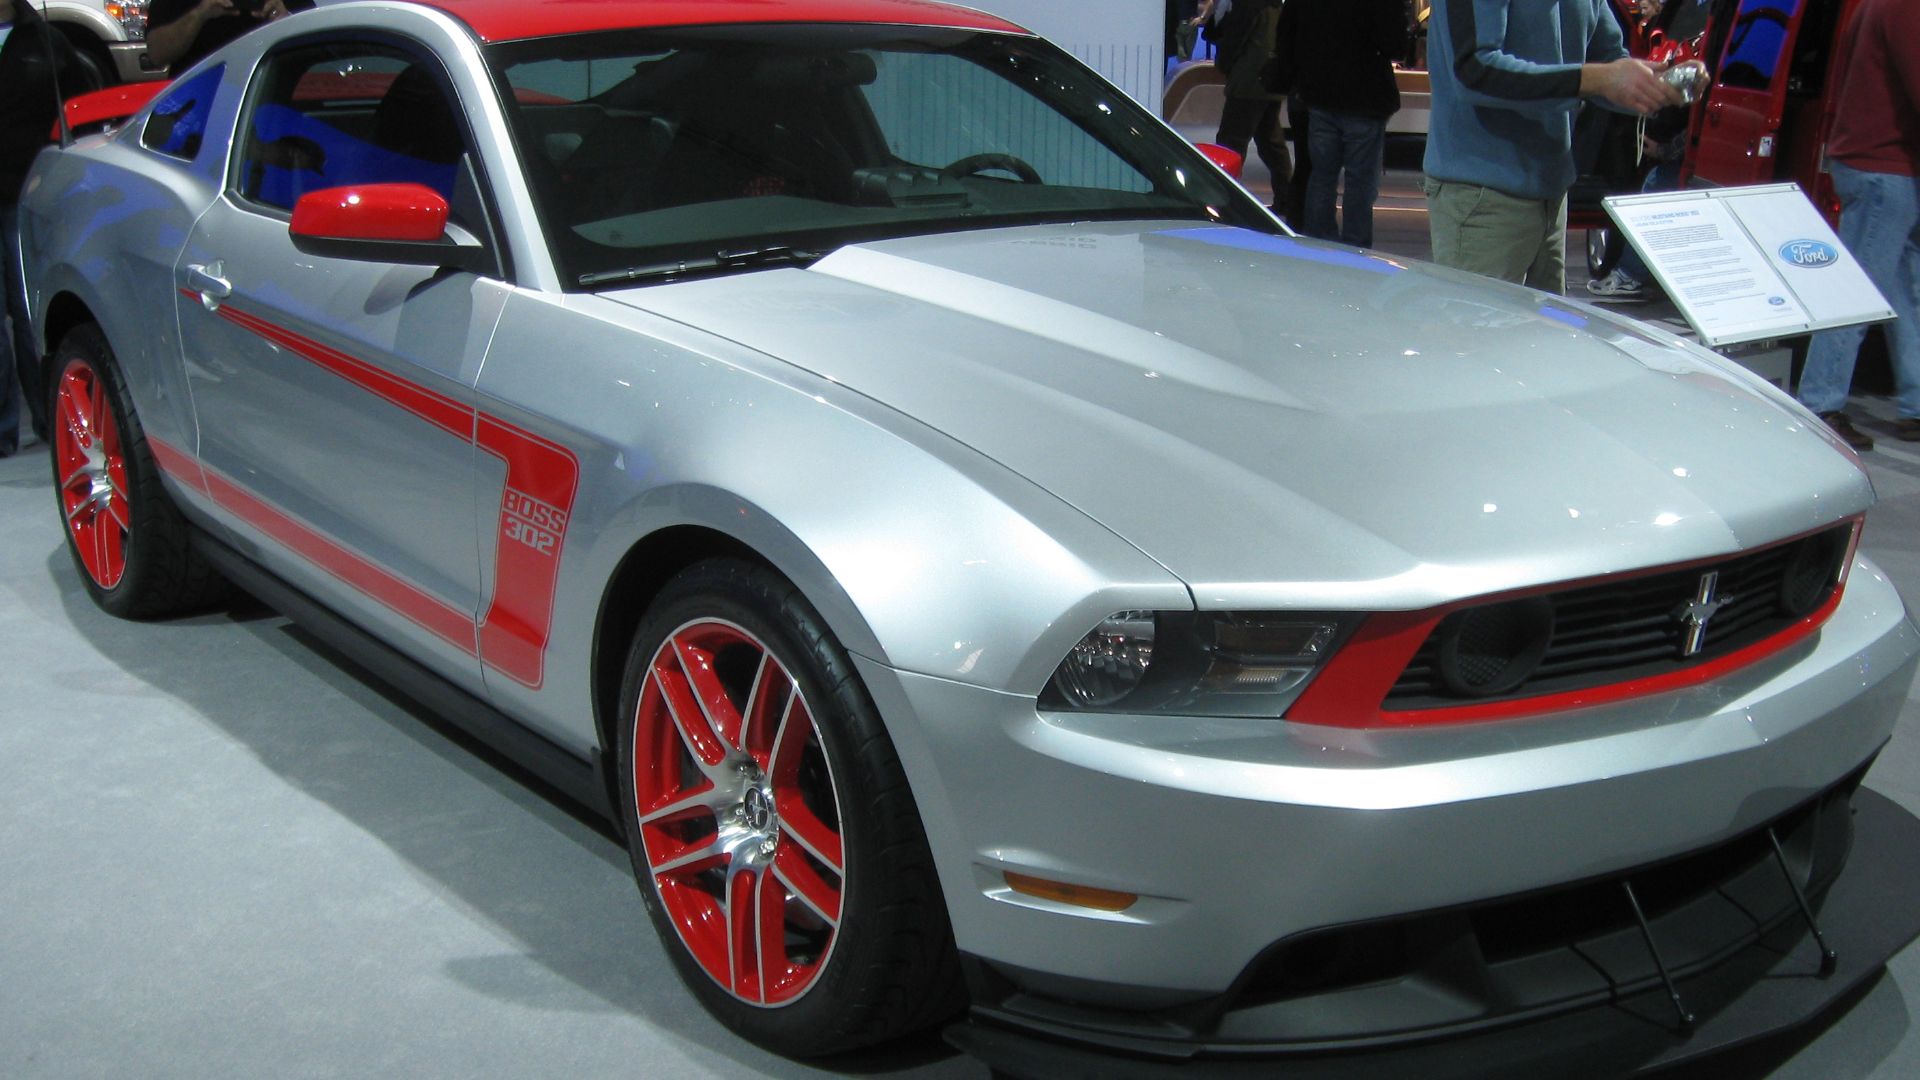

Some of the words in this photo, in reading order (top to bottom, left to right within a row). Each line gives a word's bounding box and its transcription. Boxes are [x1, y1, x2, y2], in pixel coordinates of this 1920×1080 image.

[1791, 244, 1829, 264] Ford
[502, 486, 567, 536] BOSS
[505, 516, 555, 556] 302
